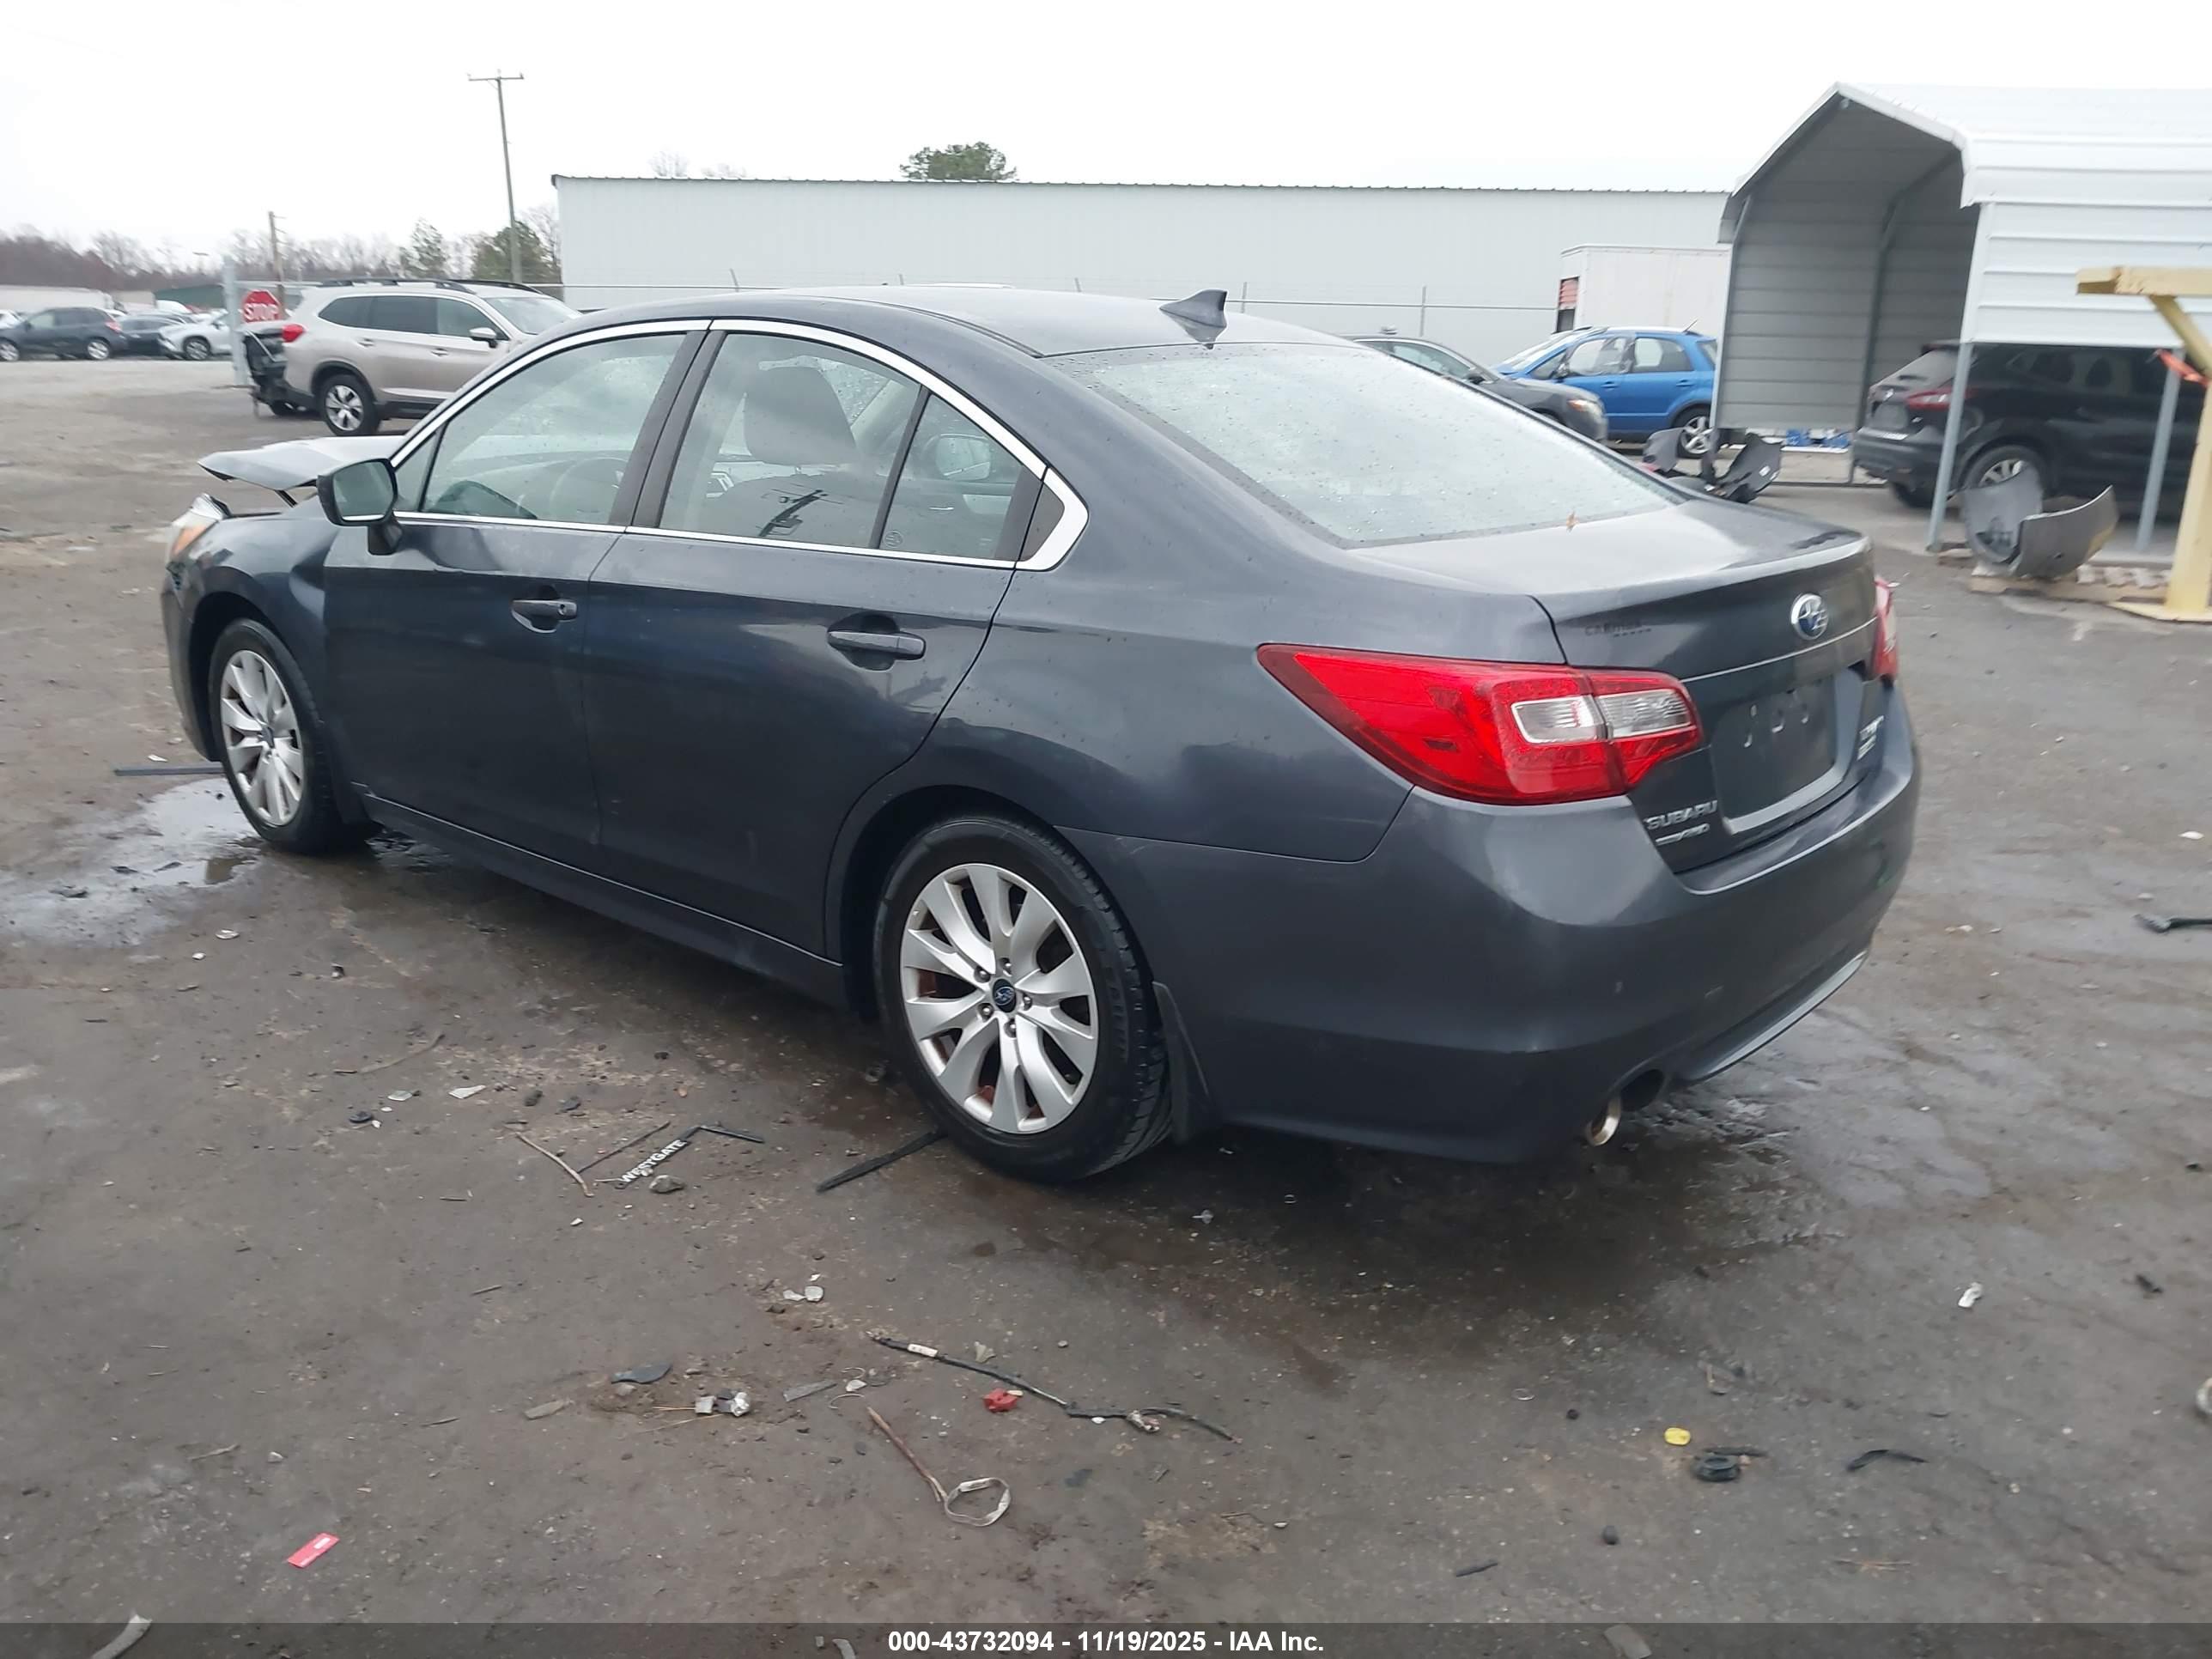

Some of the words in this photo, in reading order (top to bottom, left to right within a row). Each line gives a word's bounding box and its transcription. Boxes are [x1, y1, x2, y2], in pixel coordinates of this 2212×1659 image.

[244, 303, 278, 320] STOP
[1644, 799, 1718, 830] SUBARU
[620, 1139, 687, 1183] WESTGATE
